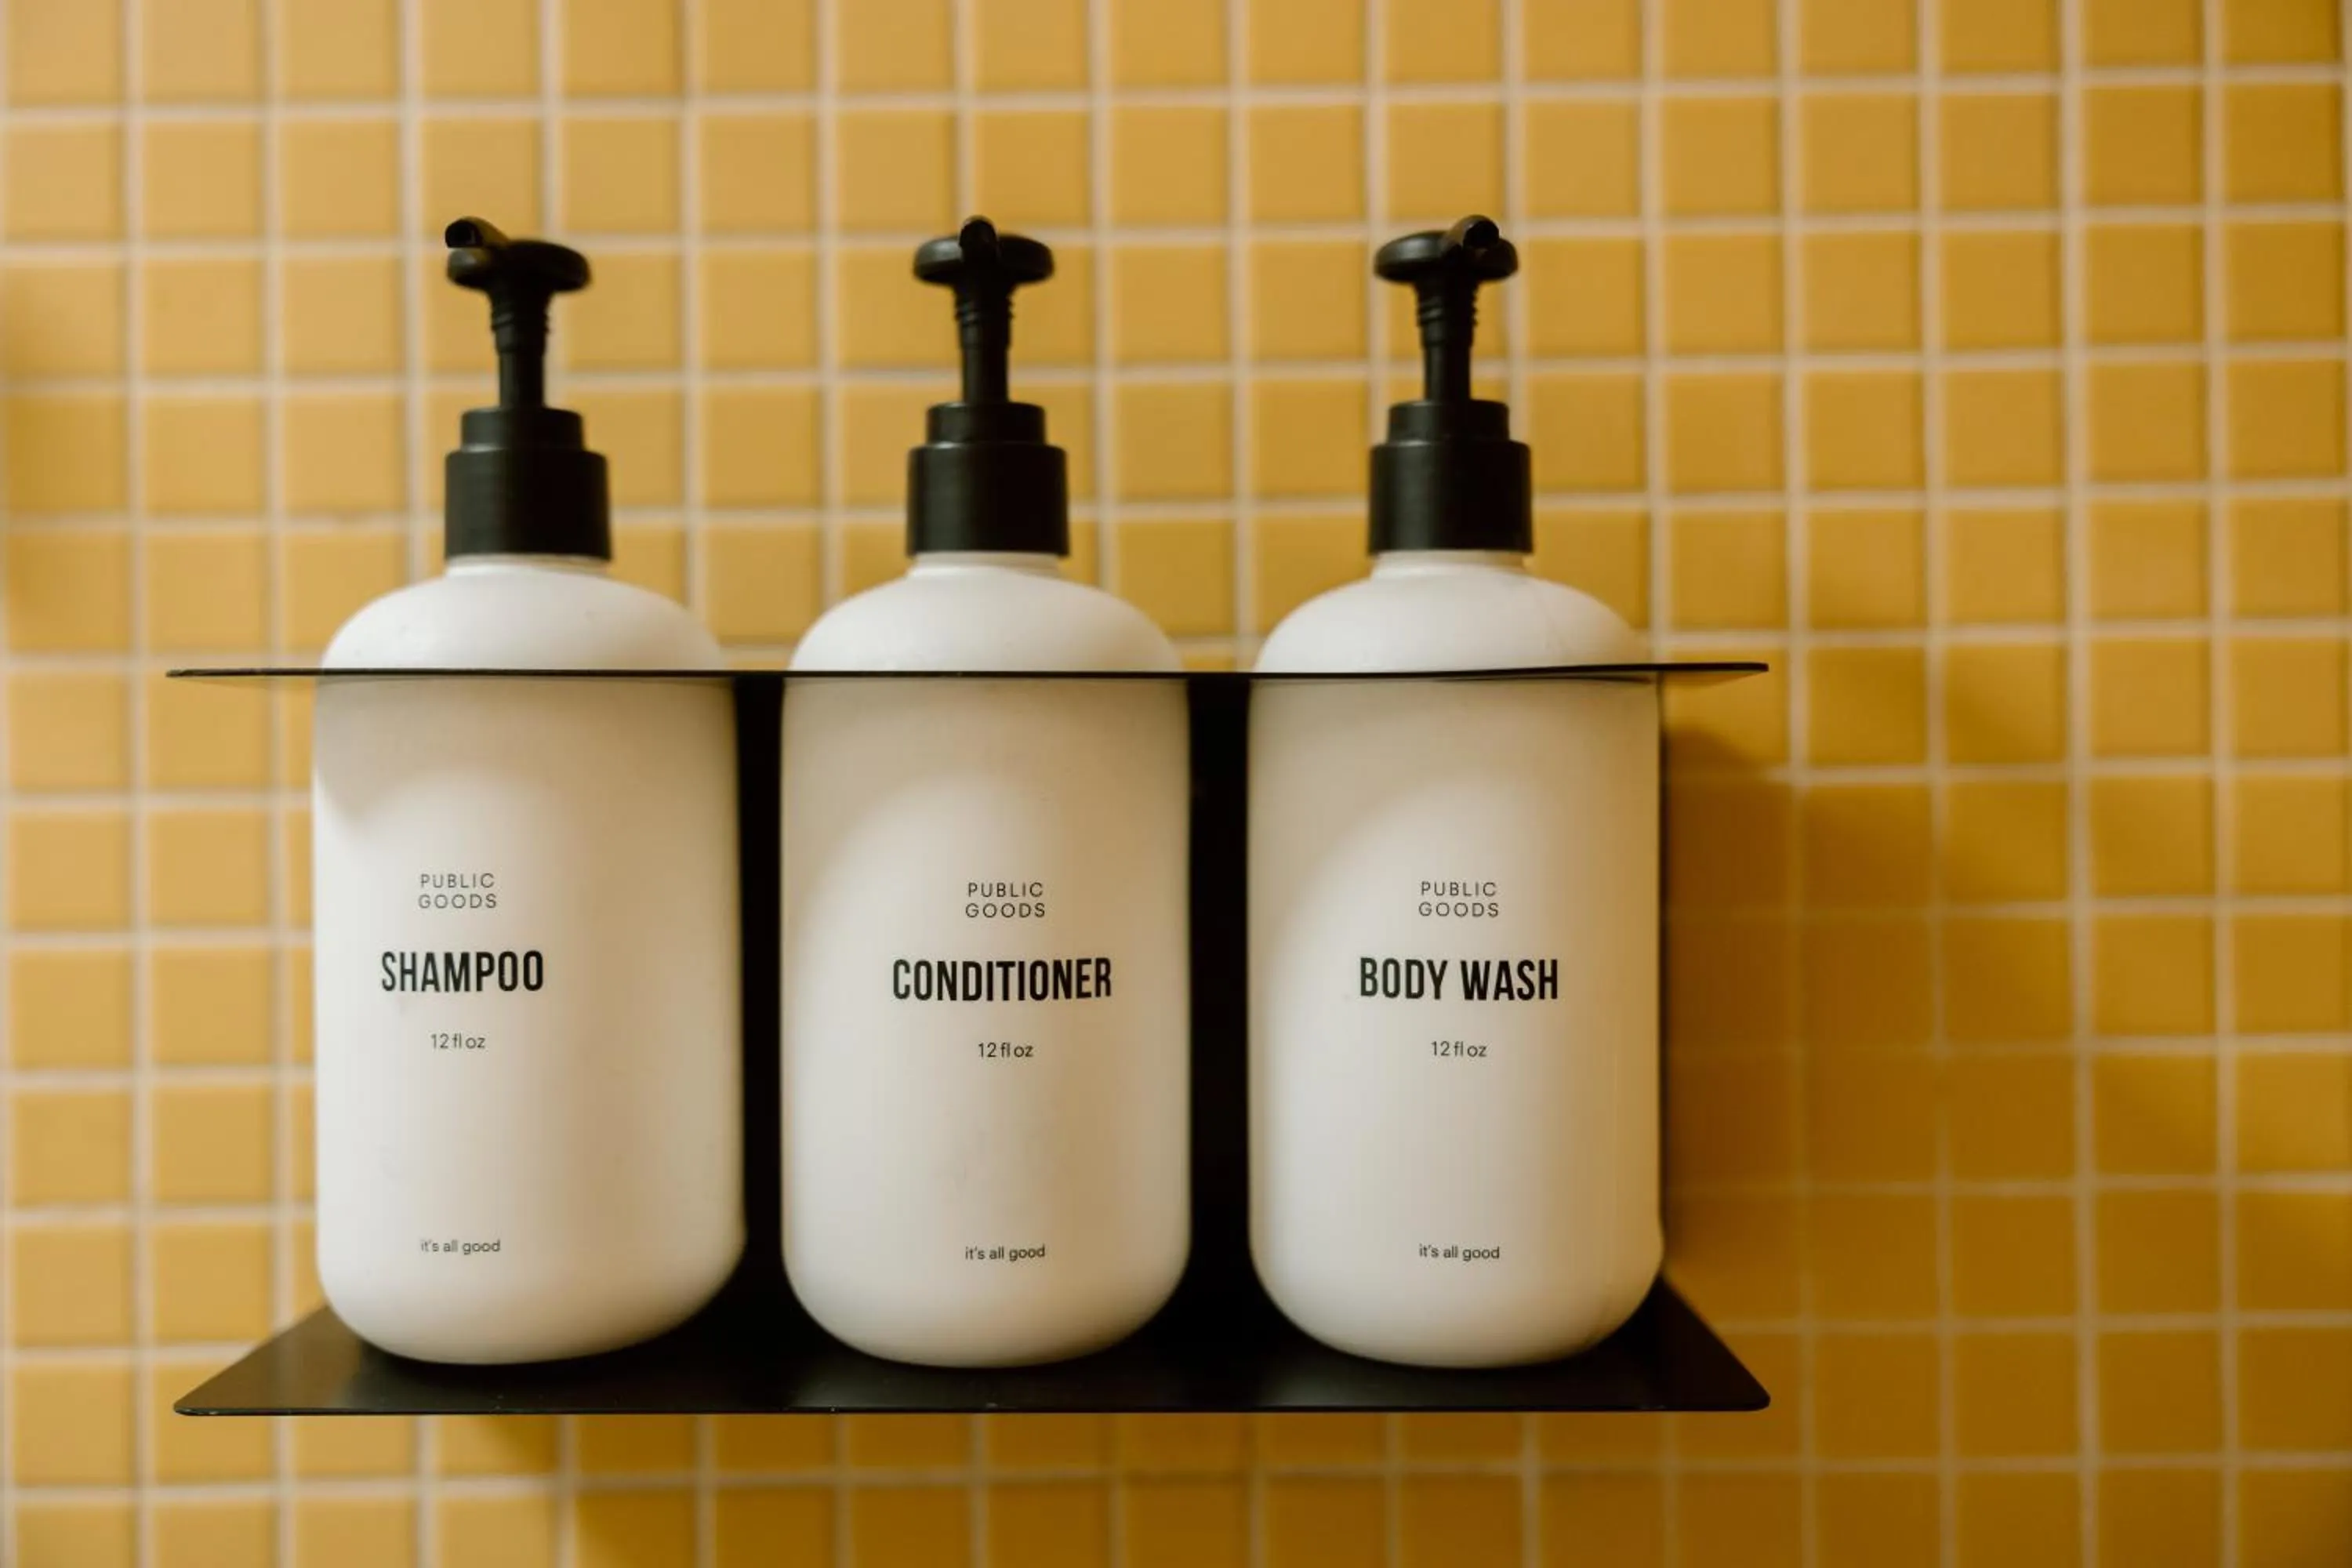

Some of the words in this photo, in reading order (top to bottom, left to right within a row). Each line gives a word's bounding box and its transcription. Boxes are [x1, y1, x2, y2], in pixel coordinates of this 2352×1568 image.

[419, 873, 495, 889] PUBLIC
[967, 881, 1044, 898] PUBLIC
[1420, 880, 1497, 898] PUBLIC
[418, 892, 497, 909] GOODS
[964, 902, 1046, 919] GOODS
[1417, 901, 1499, 919] GOODS
[380, 949, 544, 993] SHAMPOO
[892, 956, 1112, 1003] CONDITIONER
[1359, 956, 1449, 1001] BODY
[1459, 958, 1559, 1002] WASH
[430, 1033, 449, 1050] 12
[451, 1032, 463, 1050] fl
[465, 1036, 486, 1050] oz
[978, 1042, 997, 1058] 12
[999, 1041, 1011, 1058] fl
[1013, 1044, 1034, 1058] oz
[1431, 1040, 1450, 1057] 12
[1452, 1040, 1465, 1058] fl
[1466, 1044, 1487, 1058] oz
[420, 1240, 440, 1253] it's
[442, 1239, 459, 1253] all
[461, 1239, 501, 1256] good
[964, 1245, 985, 1261] it's
[988, 1245, 1005, 1261] all
[1008, 1244, 1046, 1263] good
[1418, 1243, 1439, 1258] it's
[1442, 1244, 1460, 1259] all
[1461, 1245, 1501, 1263] good
